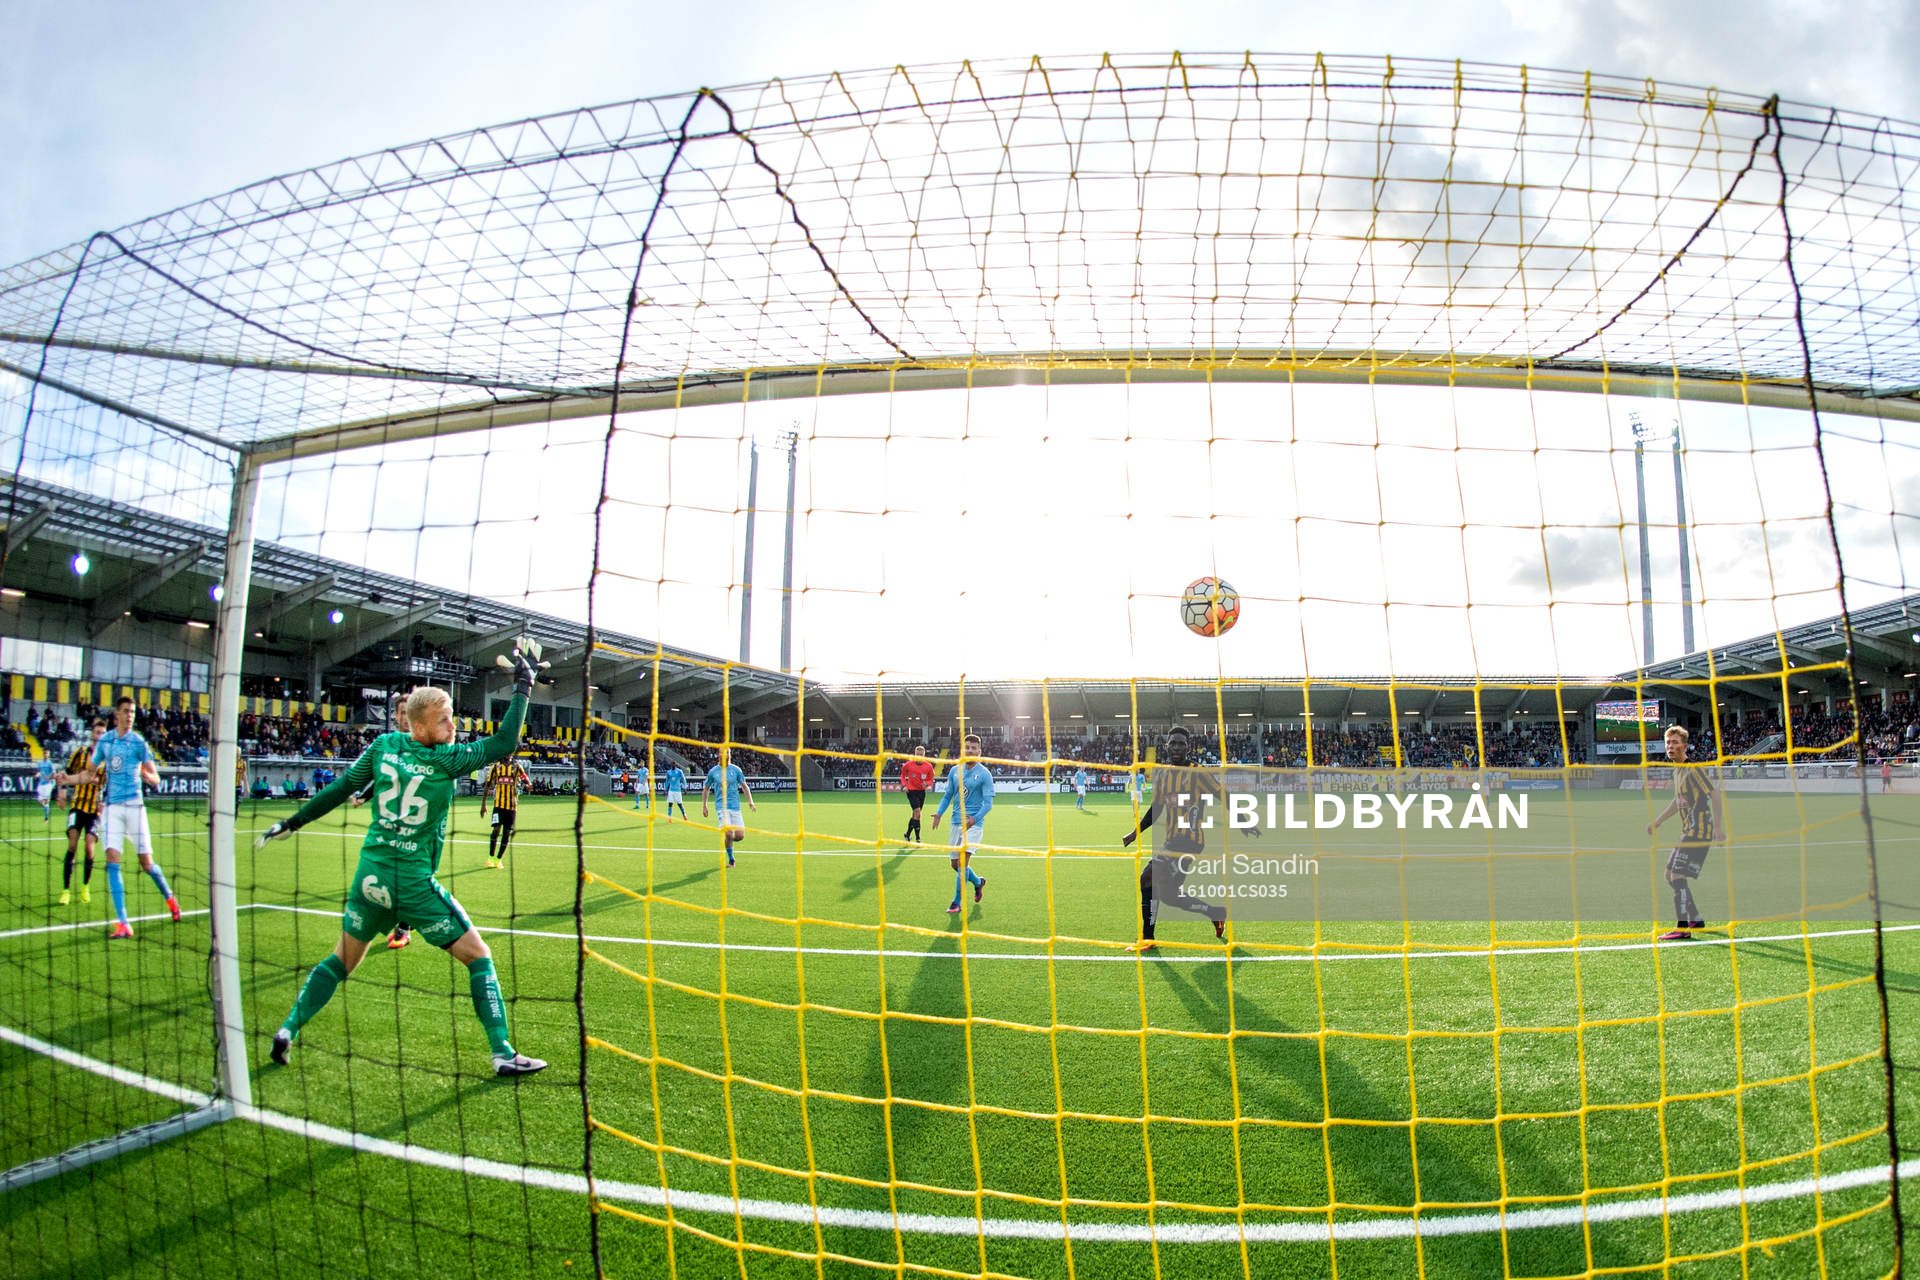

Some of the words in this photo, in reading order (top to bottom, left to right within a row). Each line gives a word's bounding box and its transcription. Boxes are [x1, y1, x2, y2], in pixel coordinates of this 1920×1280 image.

[18, 776, 33, 792] VI
[1331, 783, 1369, 791] EHRAB
[1406, 783, 1448, 791] XL-BYGG
[378, 763, 428, 826] 26
